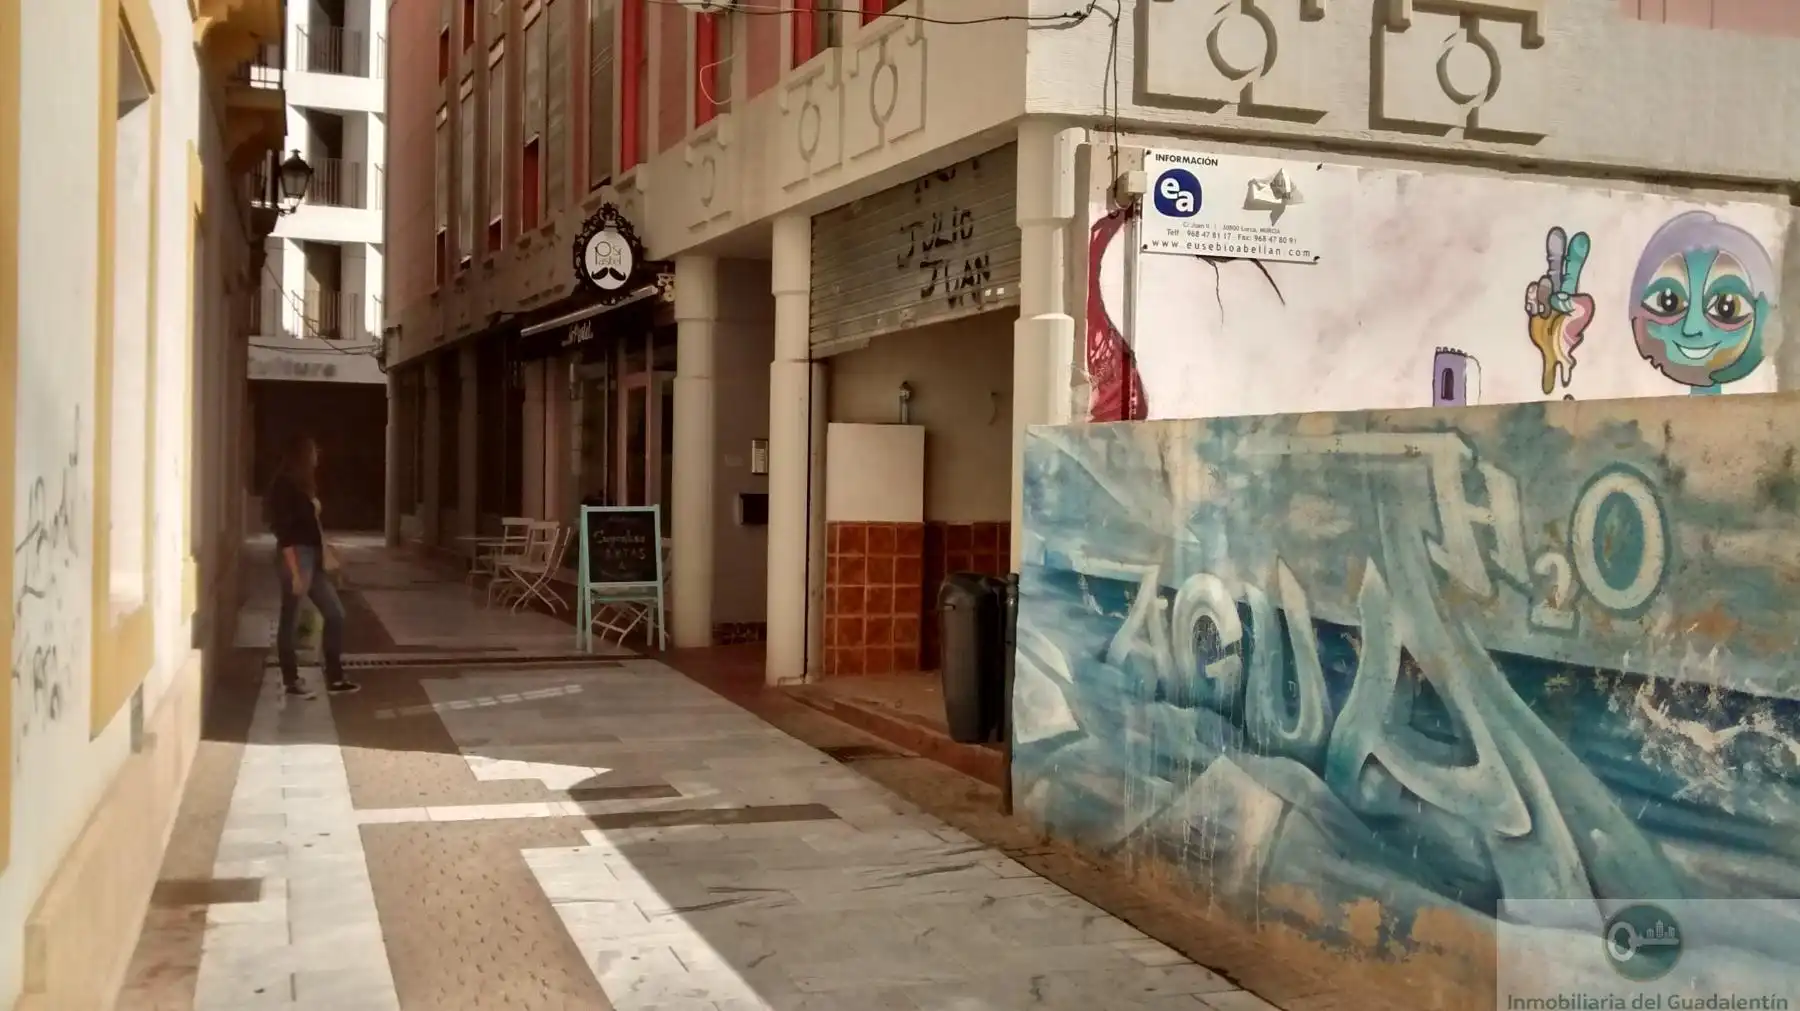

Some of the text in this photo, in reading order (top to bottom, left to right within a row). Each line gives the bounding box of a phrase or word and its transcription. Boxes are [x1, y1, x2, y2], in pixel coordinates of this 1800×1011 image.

[1155, 153, 1219, 167] INFORMACIÓN
[1160, 177, 1194, 212] ea
[1187, 230, 1200, 238] 968
